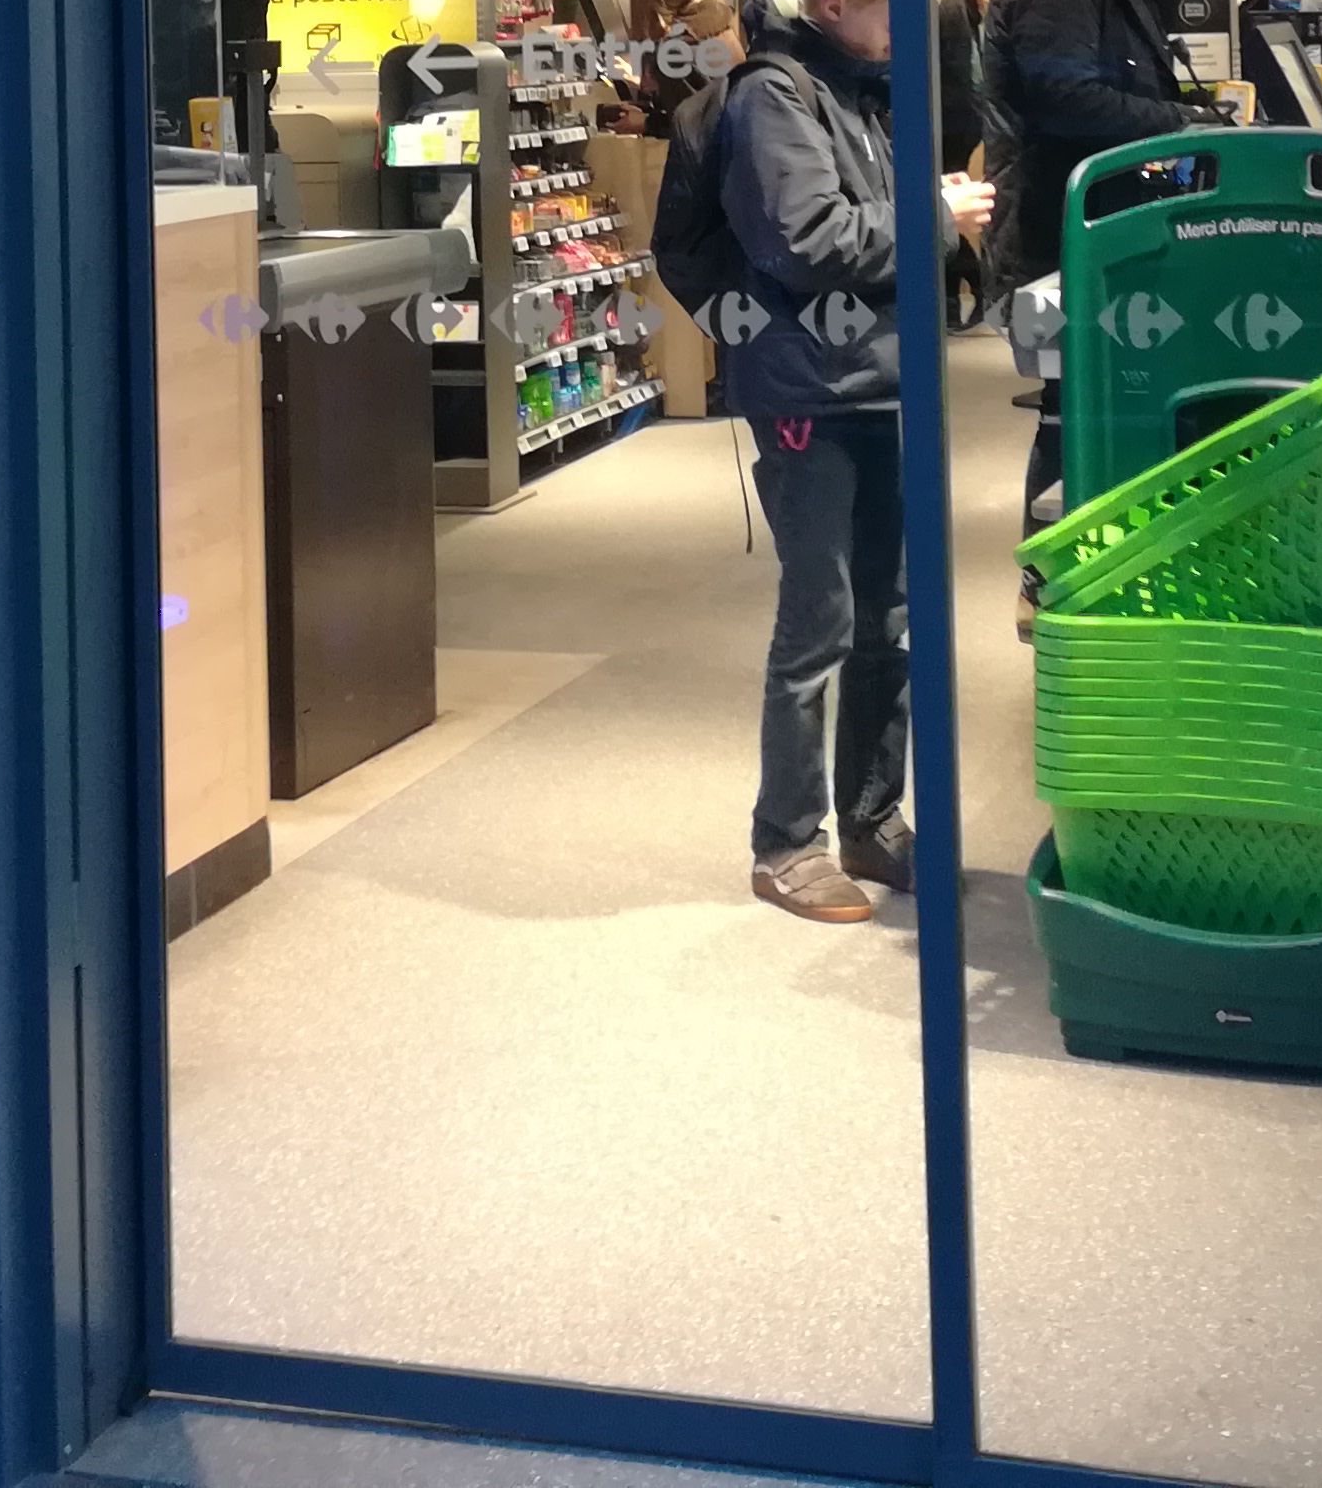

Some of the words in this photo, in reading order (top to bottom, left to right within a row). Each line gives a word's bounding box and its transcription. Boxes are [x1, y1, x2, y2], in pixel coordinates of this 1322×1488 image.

[523, 22, 732, 85] Entrée
[1176, 220, 1218, 240] Merci
[1218, 217, 1278, 235] d'utiliser
[1280, 220, 1300, 234] un
